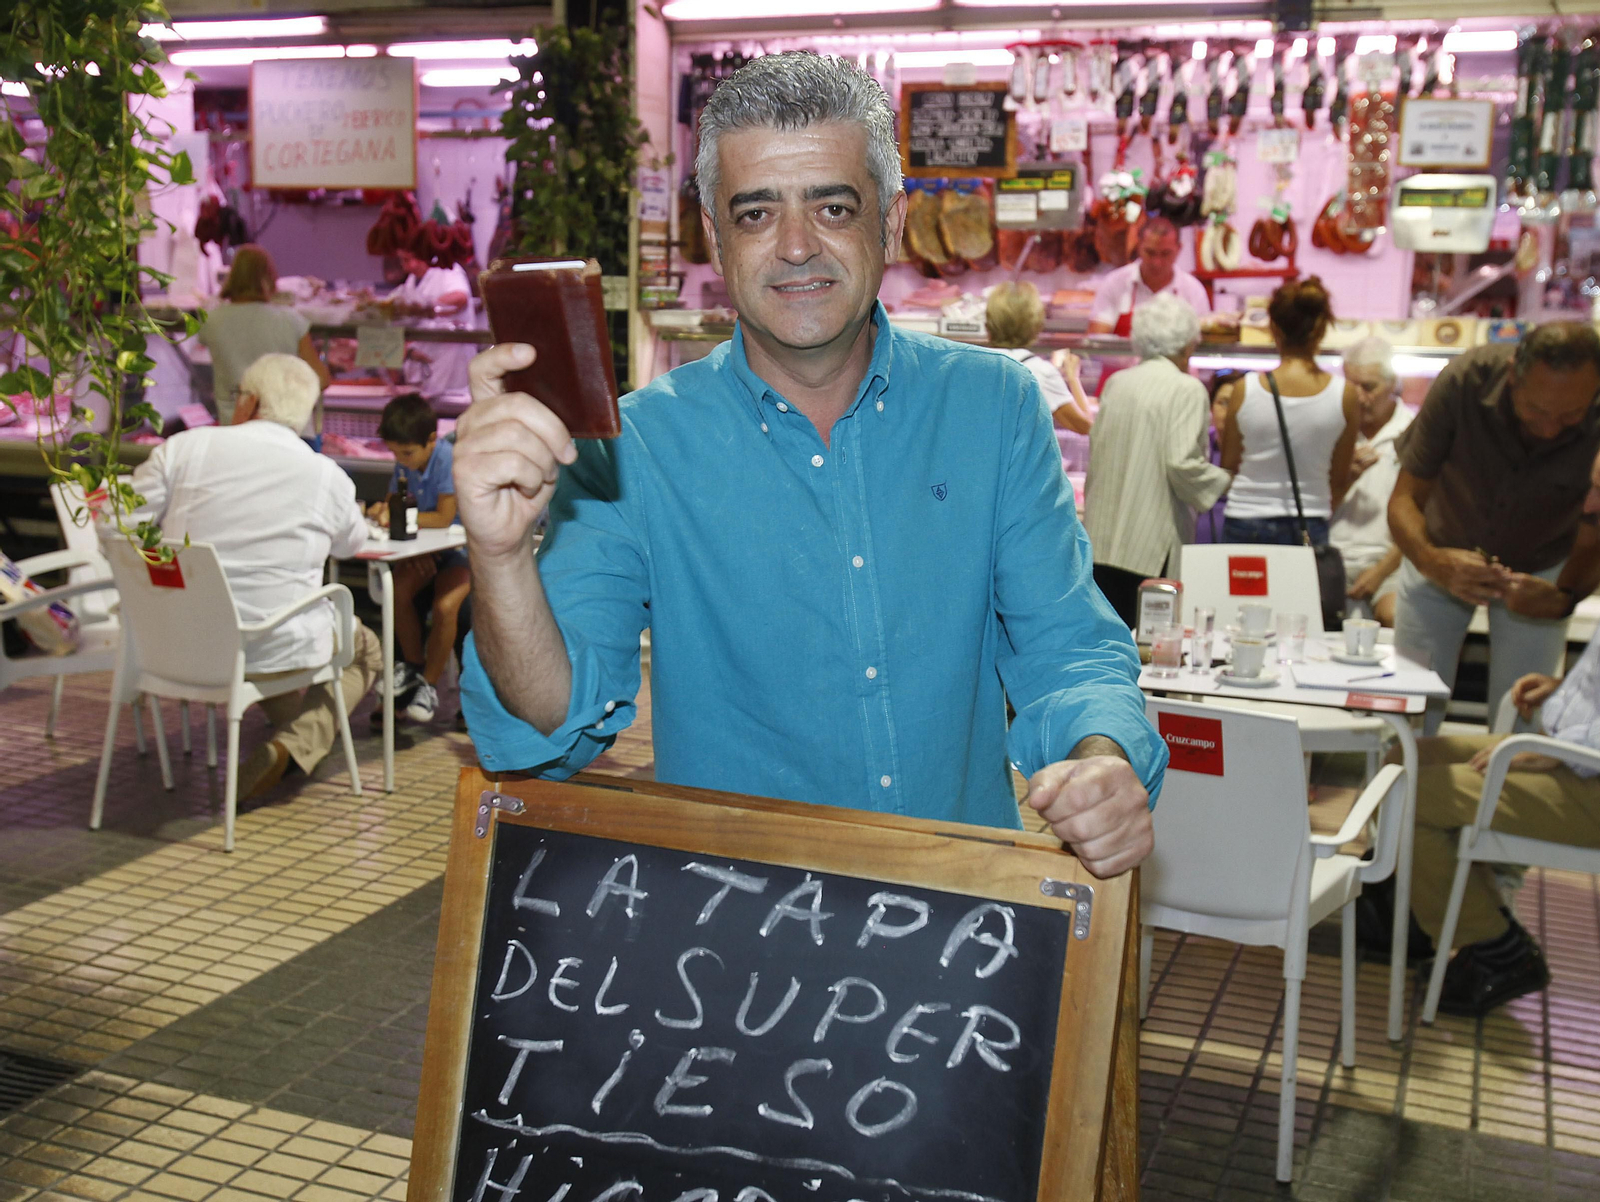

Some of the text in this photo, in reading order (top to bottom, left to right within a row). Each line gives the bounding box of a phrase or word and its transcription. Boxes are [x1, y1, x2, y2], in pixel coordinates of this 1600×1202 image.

[263, 135, 397, 172] CORTEGANA
[1166, 733, 1216, 749] Cruzcampo
[511, 848, 1018, 978] LA TAPA
[491, 939, 1021, 1071] DEL SUPER
